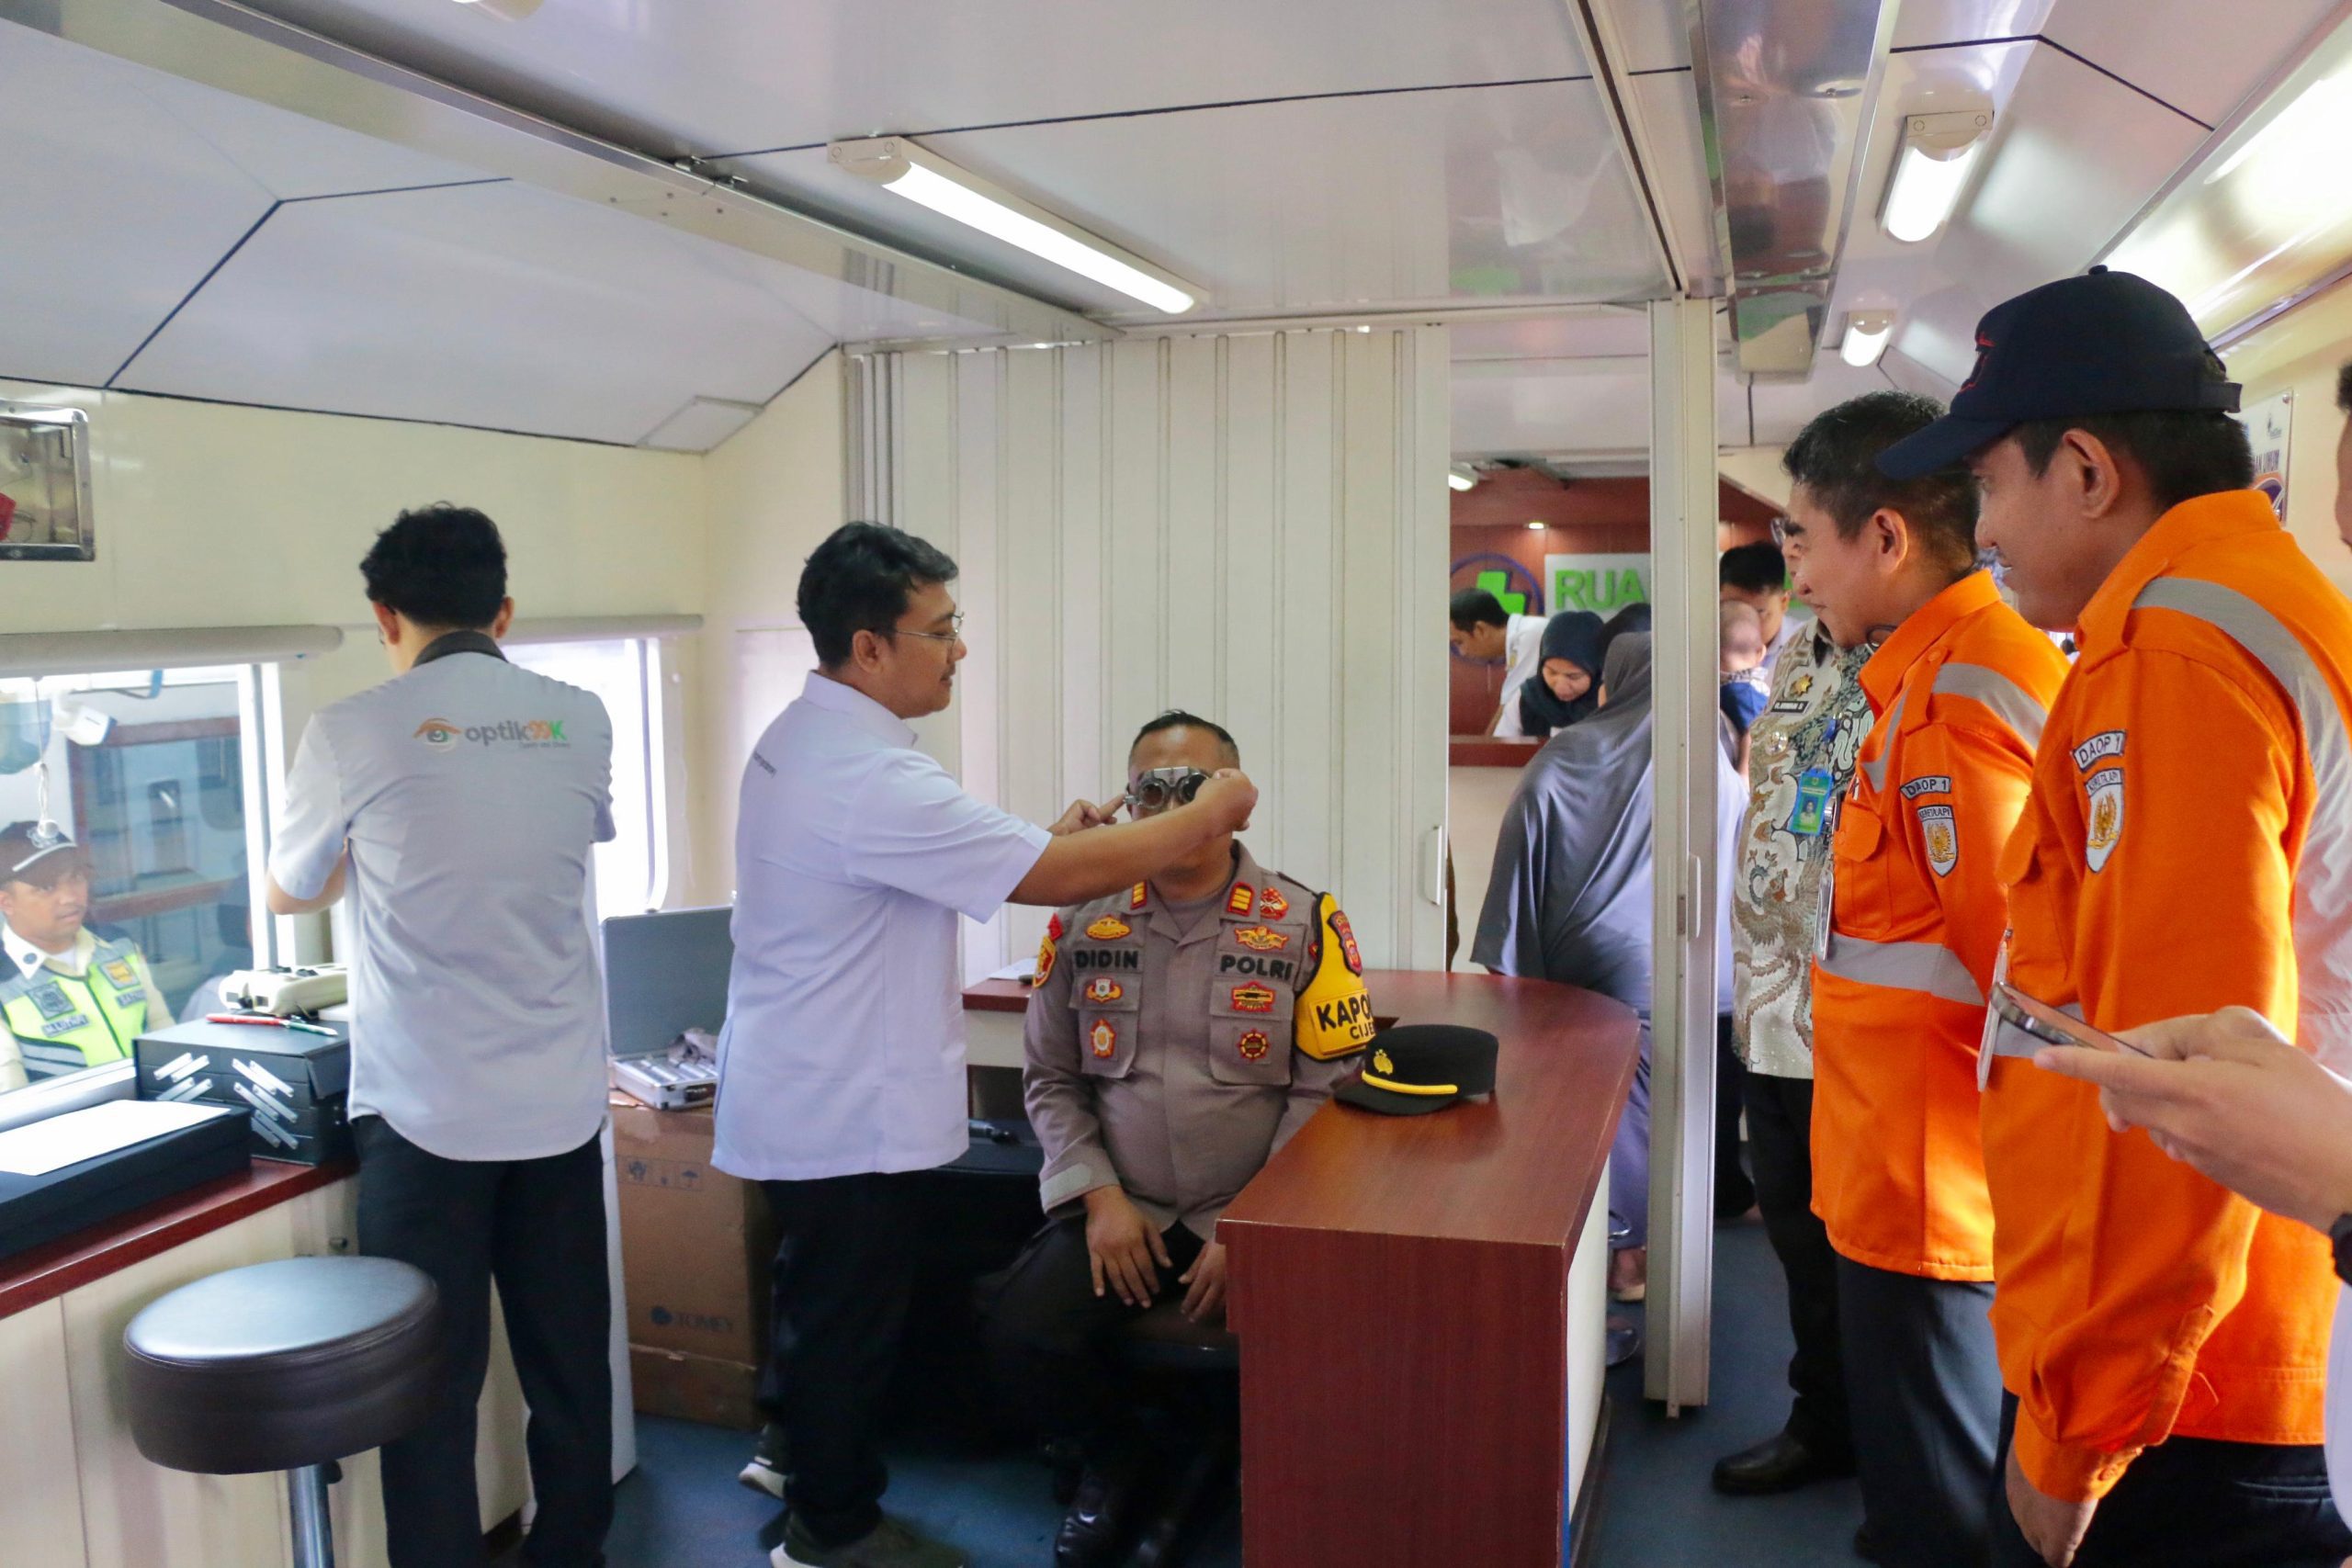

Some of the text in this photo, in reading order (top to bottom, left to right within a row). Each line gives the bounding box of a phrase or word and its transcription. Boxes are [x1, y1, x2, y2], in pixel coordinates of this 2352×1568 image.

[1555, 569, 1646, 611] RUA
[2079, 735, 2120, 763] DAOP 1
[1906, 779, 1947, 795] DAOP 1
[1073, 950, 1138, 969] DIDIN
[1220, 954, 1294, 981] POLRI
